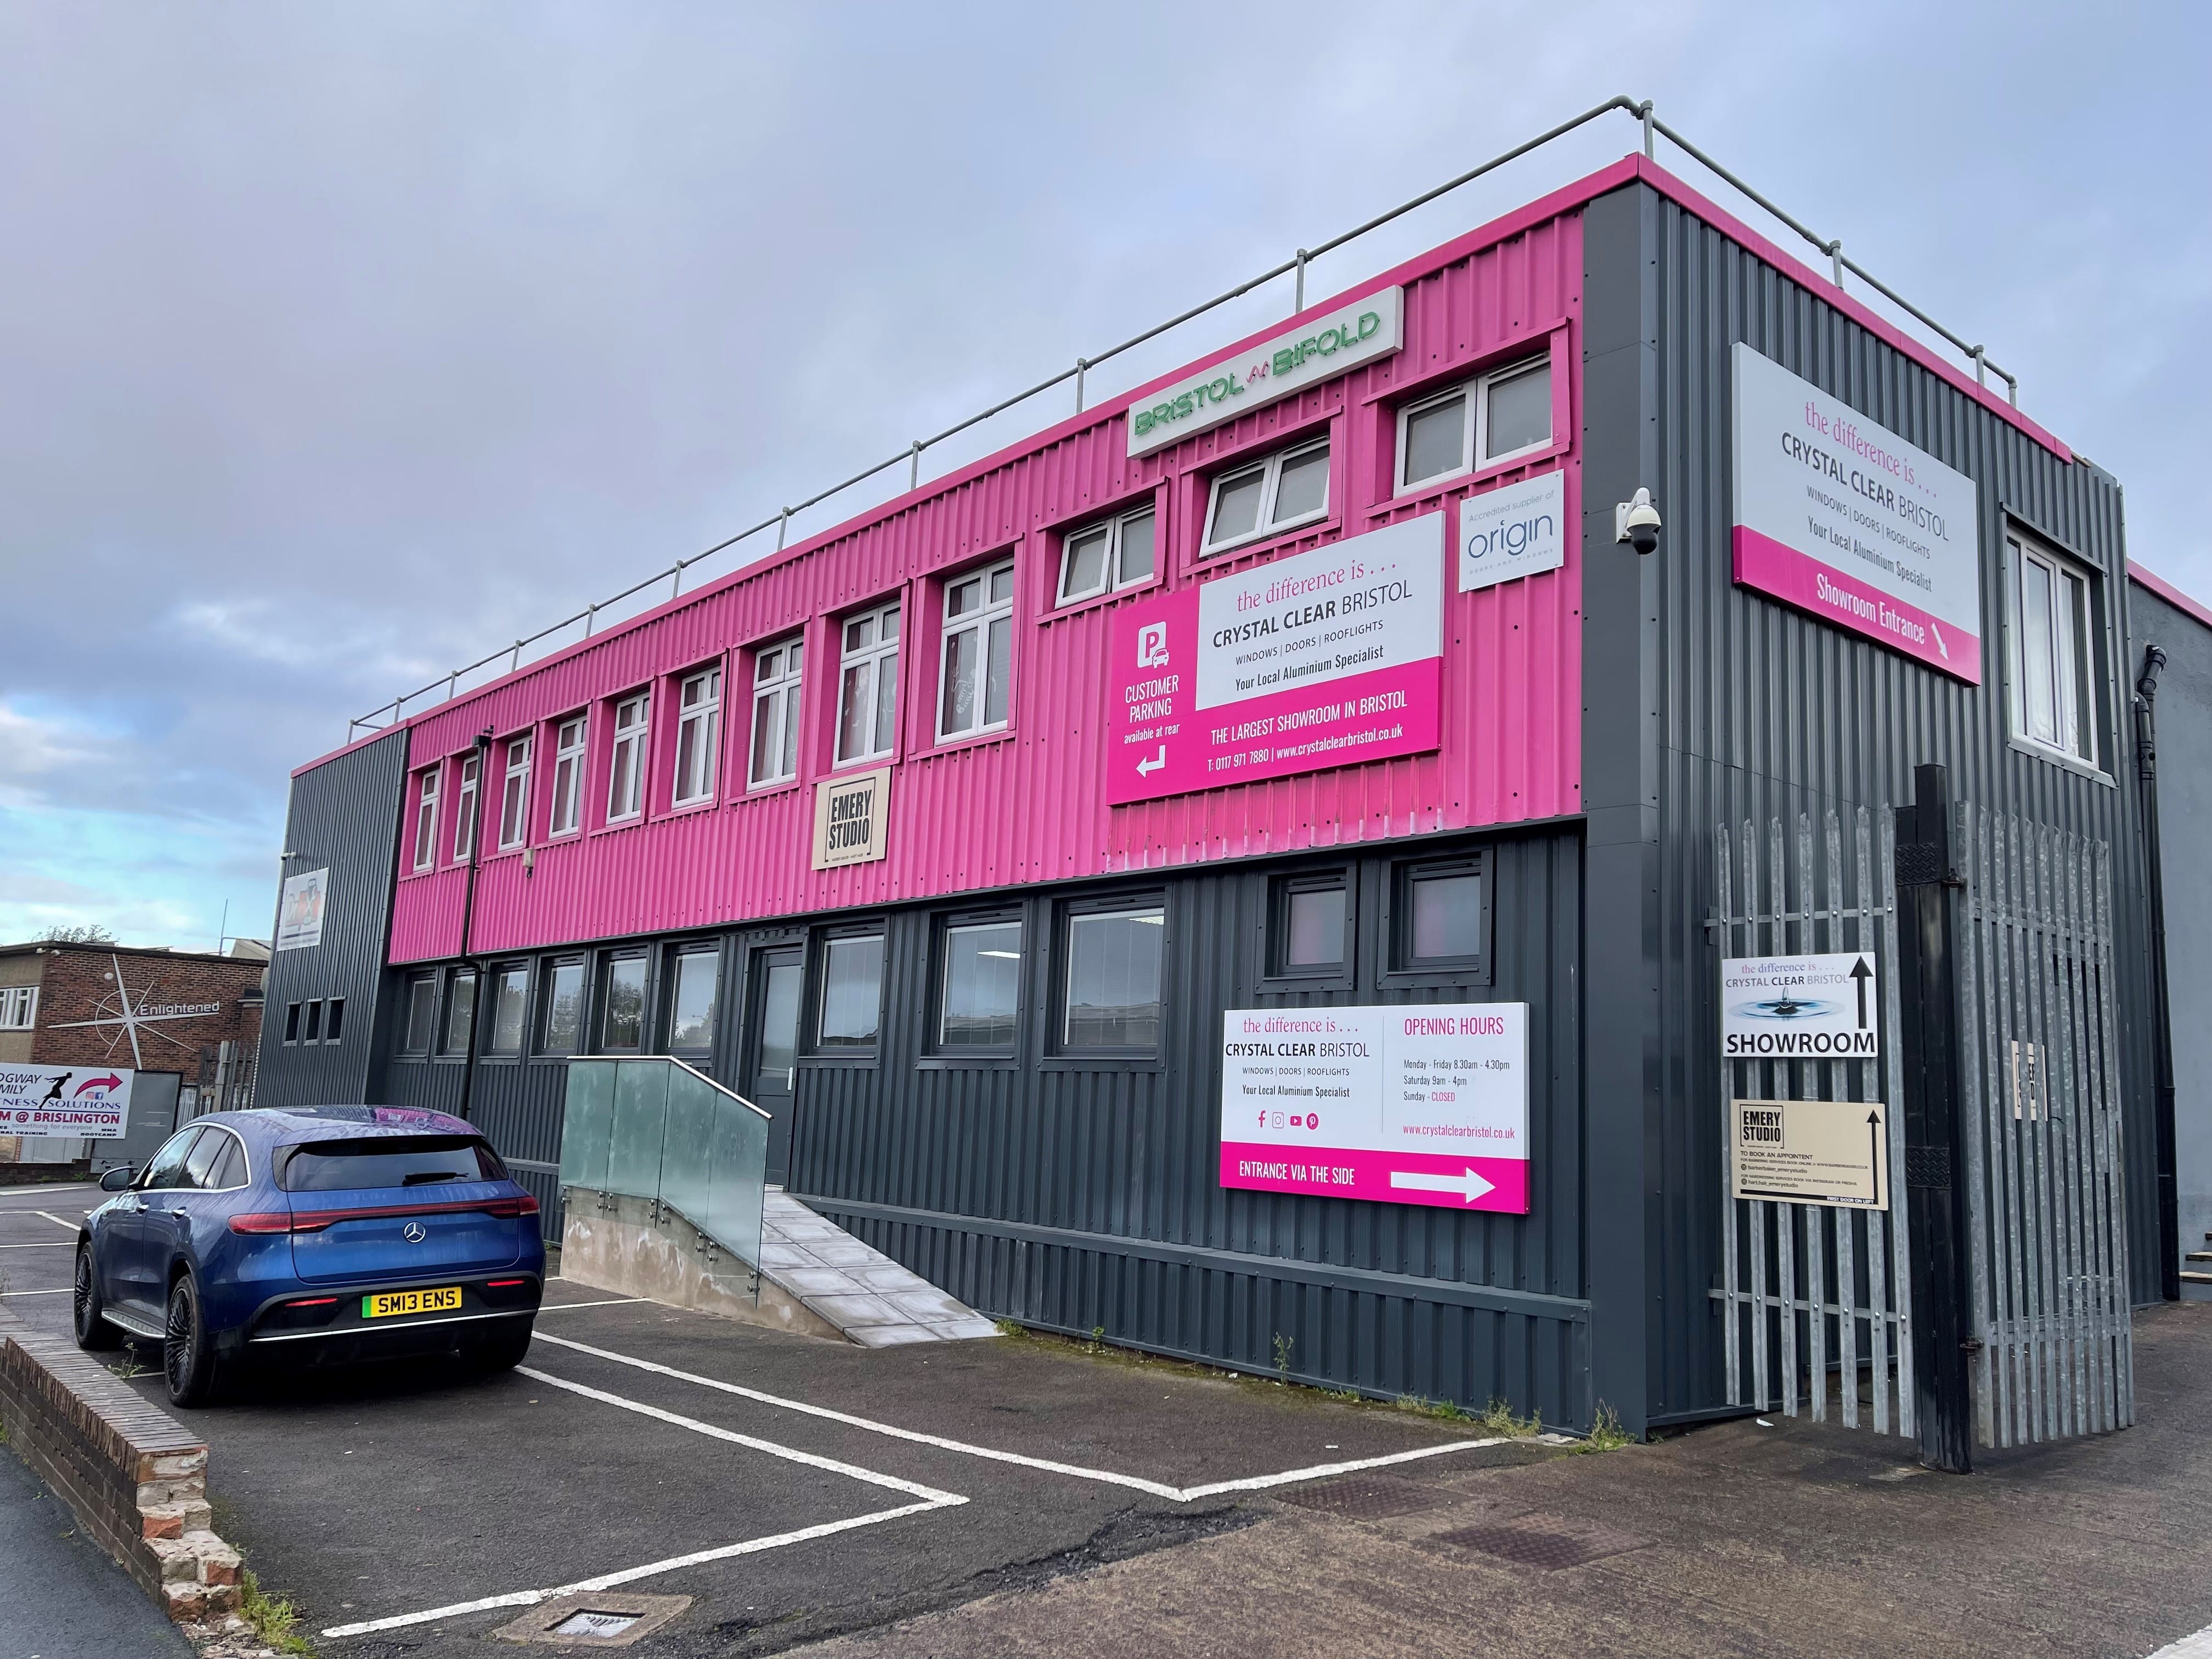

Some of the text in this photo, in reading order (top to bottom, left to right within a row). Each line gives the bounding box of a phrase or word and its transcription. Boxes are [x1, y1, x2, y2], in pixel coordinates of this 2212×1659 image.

[1272, 311, 1380, 376] BIFOLD
[1805, 402, 1829, 435] the
[1833, 417, 1900, 476] difference
[1782, 432, 1949, 541] CRYSTAL CLEAR BRISTOL
[1469, 489, 1555, 522] Accredited supplier of
[1807, 485, 1847, 516] WINDOWS
[1854, 510, 1880, 533] DOORS
[1887, 529, 1931, 559] ROOFLIGHTS
[1468, 515, 1553, 558] origin
[1470, 548, 1553, 574] DOORS AND WINDOWS
[1808, 516, 1932, 592] Your Local Aluminium Specialist
[1237, 590, 1261, 612] the
[1266, 568, 1345, 604] difference
[1213, 580, 1412, 648] CRYSTAL CLEAR BRISTOL
[1816, 572, 1925, 645] Showroom Entrance
[1235, 646, 1278, 665] WINDOWS
[1285, 636, 1316, 653] DOORS
[1324, 619, 1384, 644] ROOFLIGHTS
[1235, 644, 1384, 691] Your Local Aluminium Specialist
[1125, 674, 1179, 703] CUSTOMER
[1130, 697, 1172, 724] PARKING
[1211, 690, 1407, 746] THE LARGEST SHOWROOM IN BRISTOL
[1124, 724, 1180, 744] available at rear
[1207, 759, 1214, 772] T:
[1216, 755, 1232, 770] 0117
[1233, 753, 1247, 768] 971
[1249, 748, 1269, 764] 7880
[1276, 723, 1403, 760] www.crystalclearbristol.co.uk
[831, 789, 872, 822] EMERY
[829, 817, 869, 850] STUDIO
[1726, 974, 1849, 988] CRYSTAL CLEAR BRISTOL
[1742, 964, 1756, 974] the
[1758, 962, 1805, 973] difference
[140, 1001, 219, 1015] Enlightened
[1244, 1017, 1261, 1032] the
[1265, 1017, 1322, 1032] difference
[1404, 1017, 1504, 1035] OPENING HOURS
[1226, 1042, 1370, 1057] CRYSTAL CLEAR BRISTOL
[1727, 1032, 1875, 1053] SHOWROOM
[1279, 1067, 1302, 1075] DOORS
[1307, 1068, 1350, 1076] ROOFLIGHTS
[1404, 1059, 1426, 1070] Monday
[1434, 1059, 1452, 1070] Friday
[1454, 1059, 1477, 1070] 8.30am
[1485, 1059, 1510, 1071] 4.30pm
[1243, 1084, 1350, 1098] Your Local Aluminium Specialist
[1404, 1075, 1430, 1086] Saturday
[1432, 1076, 1446, 1085] 9am
[1453, 1076, 1467, 1087] 4pm
[0, 1098, 121, 1110] NESS SOLUTIONS
[1403, 1091, 1425, 1102] Sunday
[1431, 1092, 1455, 1102] CLOSED
[16, 1111, 29, 1123] @
[33, 1111, 120, 1124] BRISLINGTON
[1743, 1111, 1781, 1126] EMERY
[1403, 1125, 1515, 1139] www.crystalclearbristol.co.uk
[1743, 1126, 1781, 1142] STUDIO
[1239, 1160, 1355, 1186] ENTRANCE VIA THE SIDE
[379, 1290, 455, 1313] SM13 ENS
